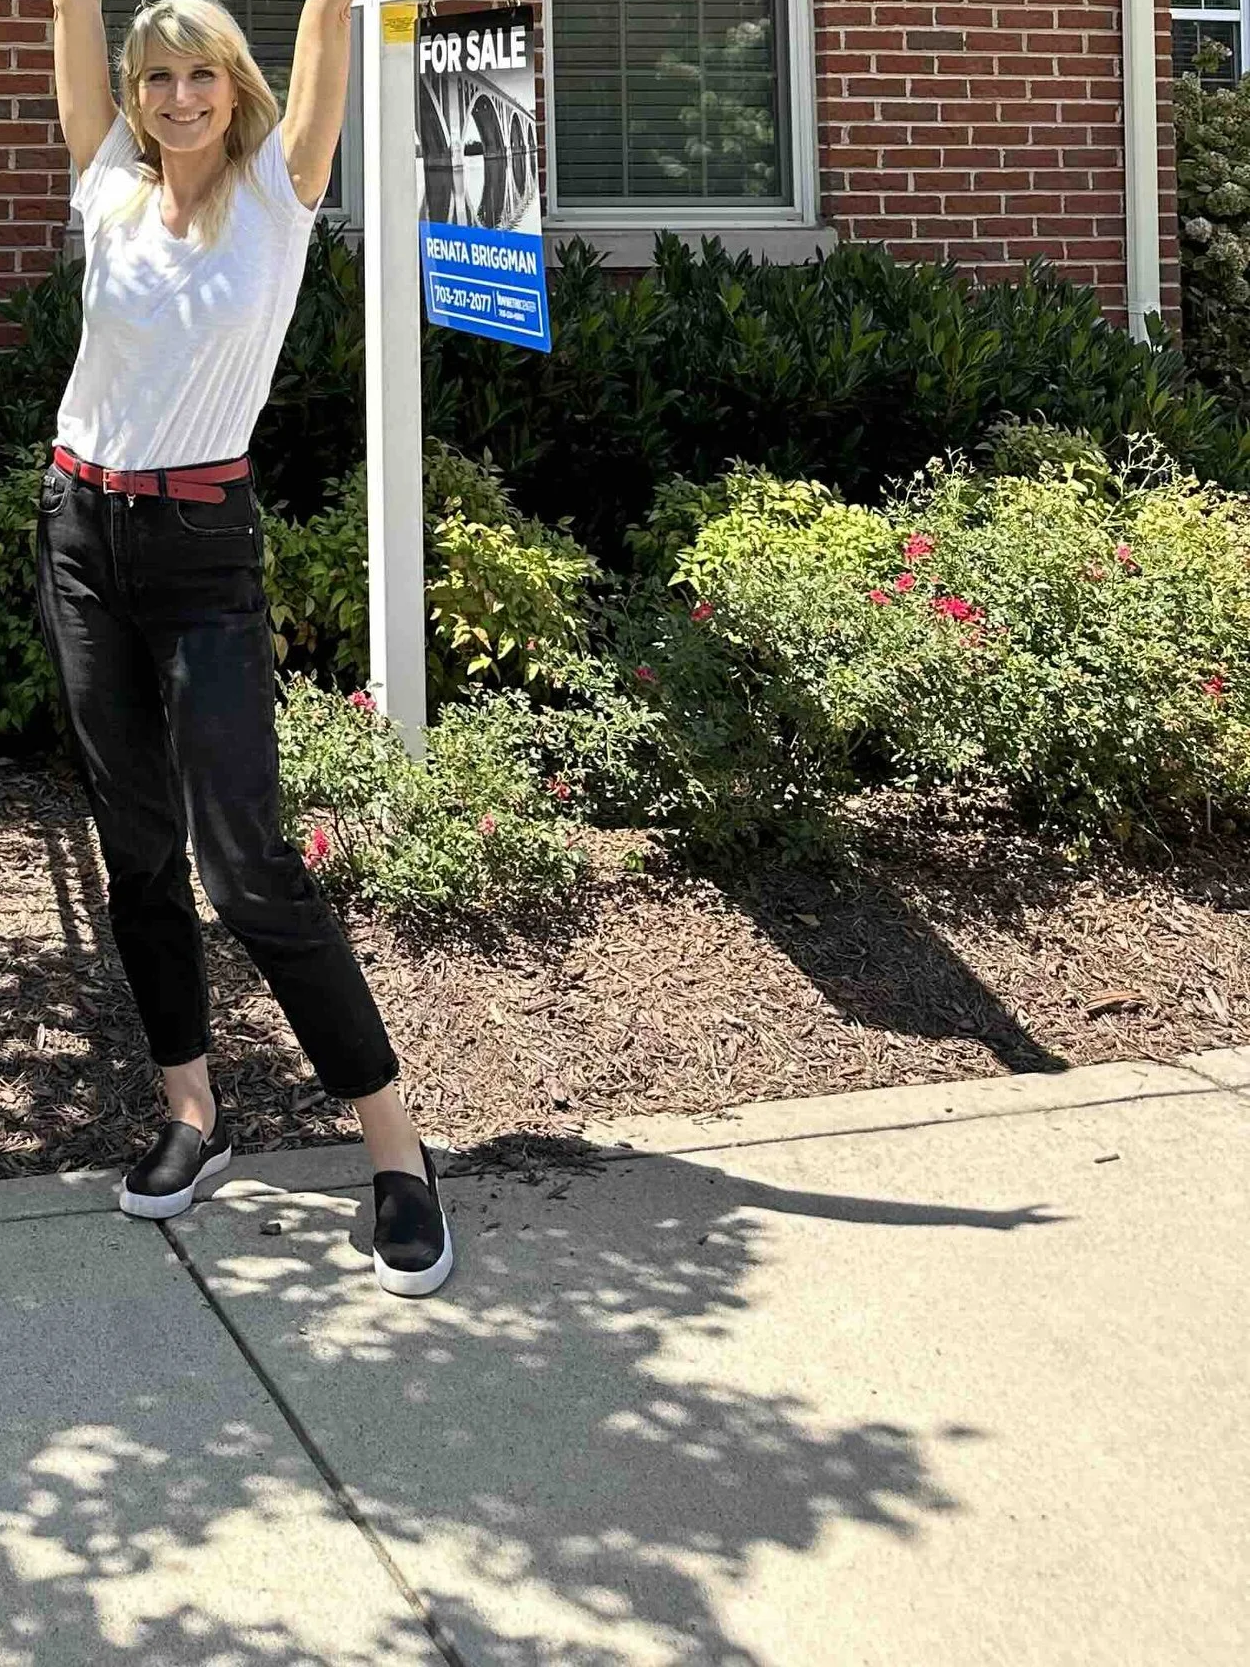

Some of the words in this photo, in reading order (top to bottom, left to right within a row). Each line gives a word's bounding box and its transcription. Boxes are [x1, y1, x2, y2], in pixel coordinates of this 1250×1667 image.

[419, 33, 462, 74] FOR
[466, 25, 527, 72] SALE
[426, 237, 470, 264] RENATA
[471, 243, 537, 276] BRIGGMAN
[434, 285, 492, 313] 703-217-2077
